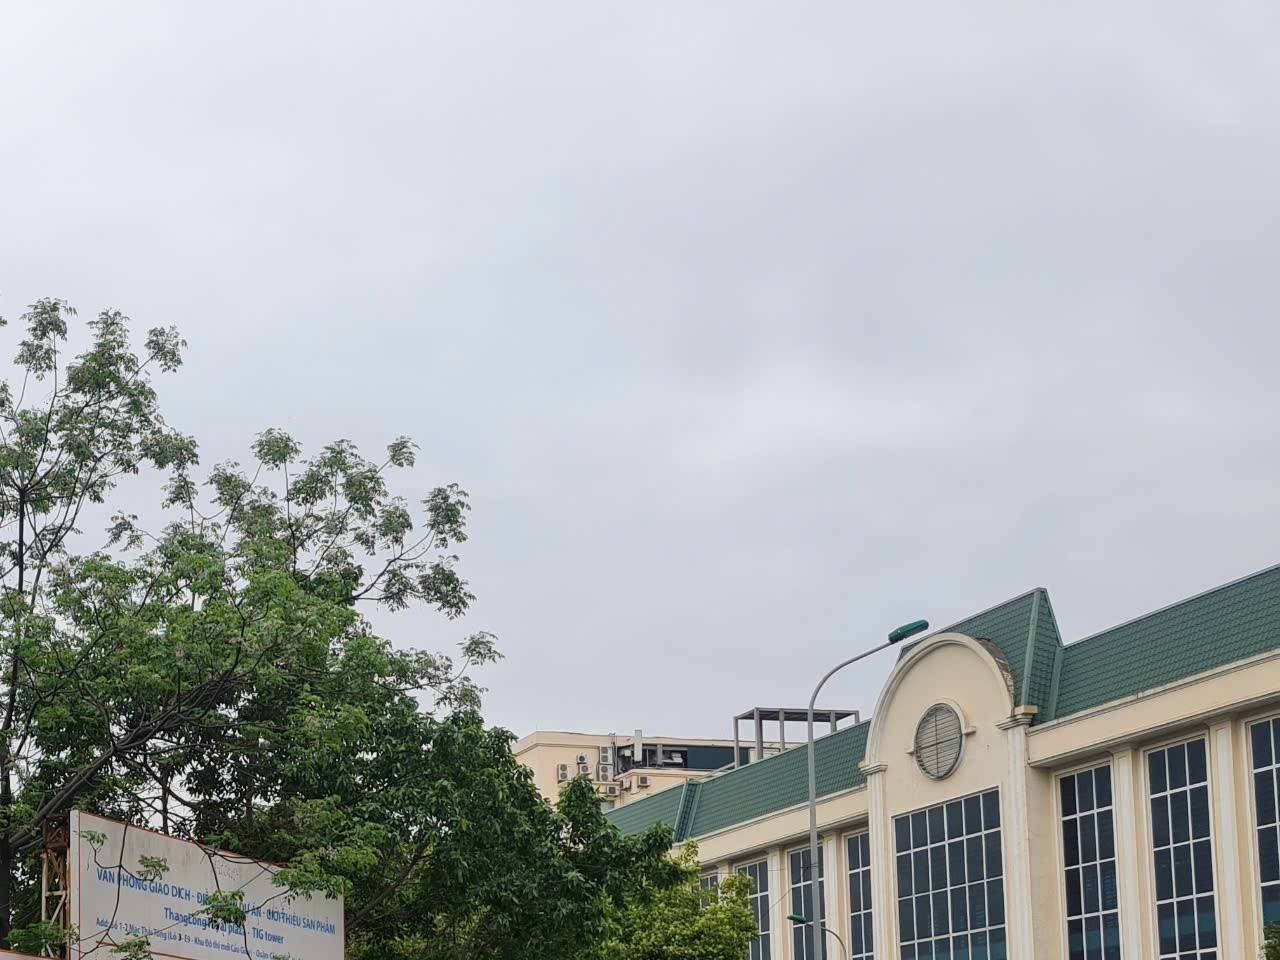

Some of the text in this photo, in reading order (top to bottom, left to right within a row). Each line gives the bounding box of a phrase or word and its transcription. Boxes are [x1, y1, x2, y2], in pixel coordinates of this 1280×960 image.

[149, 882, 170, 896] GIAO
[316, 917, 336, 934] PHẨM
[252, 926, 264, 940] TIG
[265, 931, 286, 944] tower
